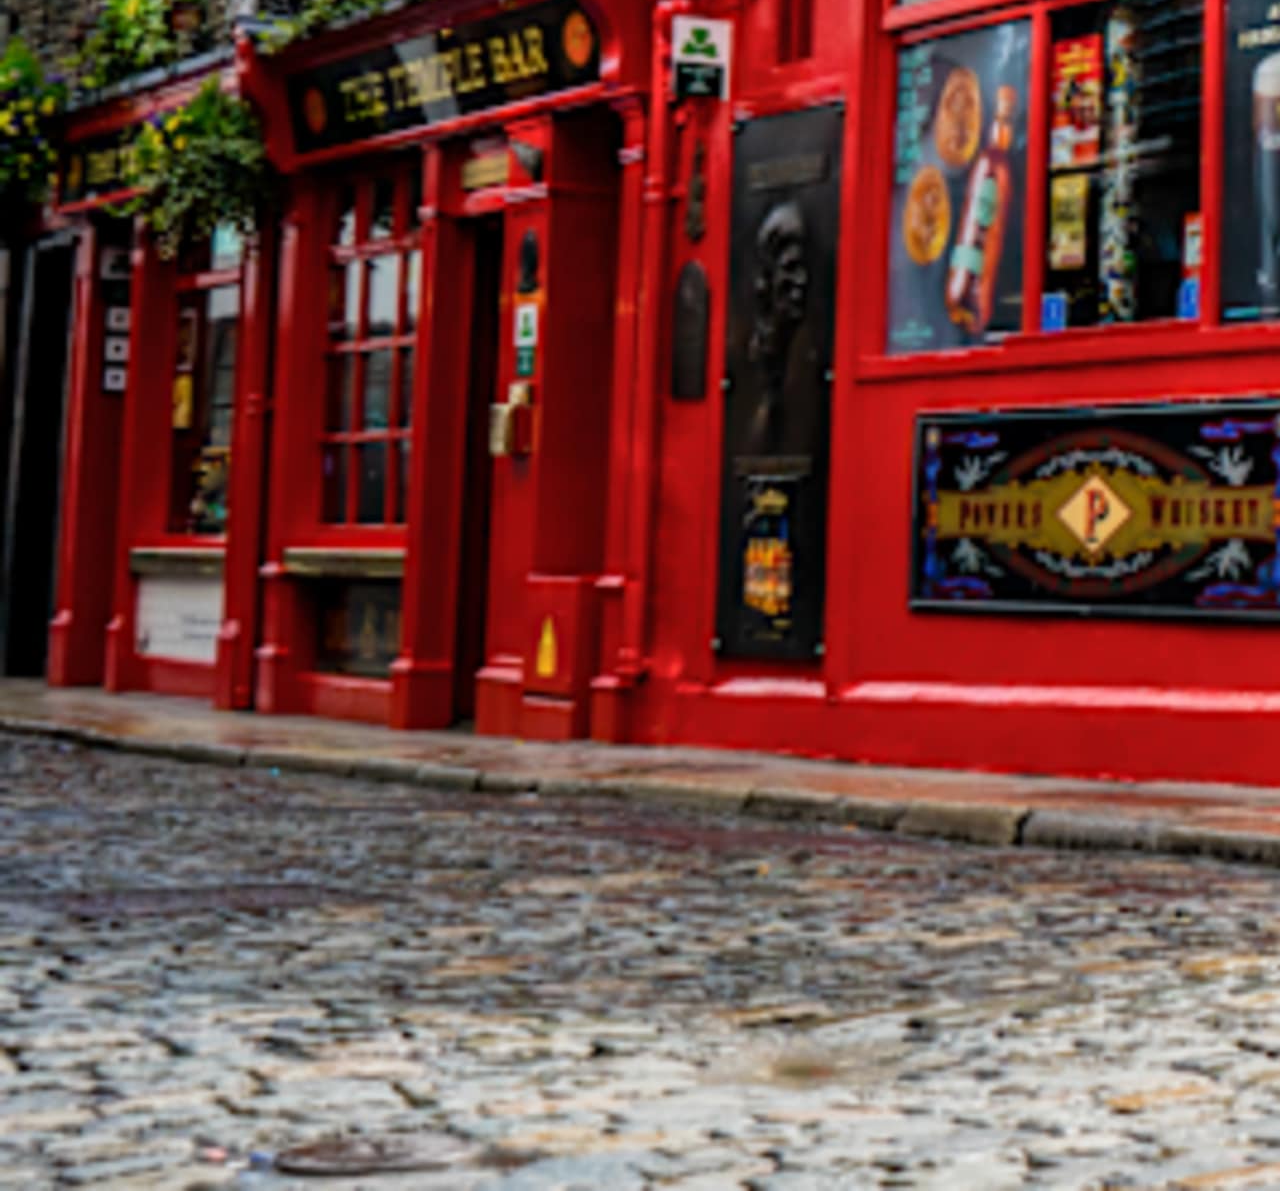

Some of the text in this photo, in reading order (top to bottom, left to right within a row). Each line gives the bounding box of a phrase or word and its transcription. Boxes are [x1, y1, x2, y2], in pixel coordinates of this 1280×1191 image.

[389, 39, 487, 110] TEMPLE
[490, 24, 549, 85] BAR
[1087, 487, 1109, 542] P
